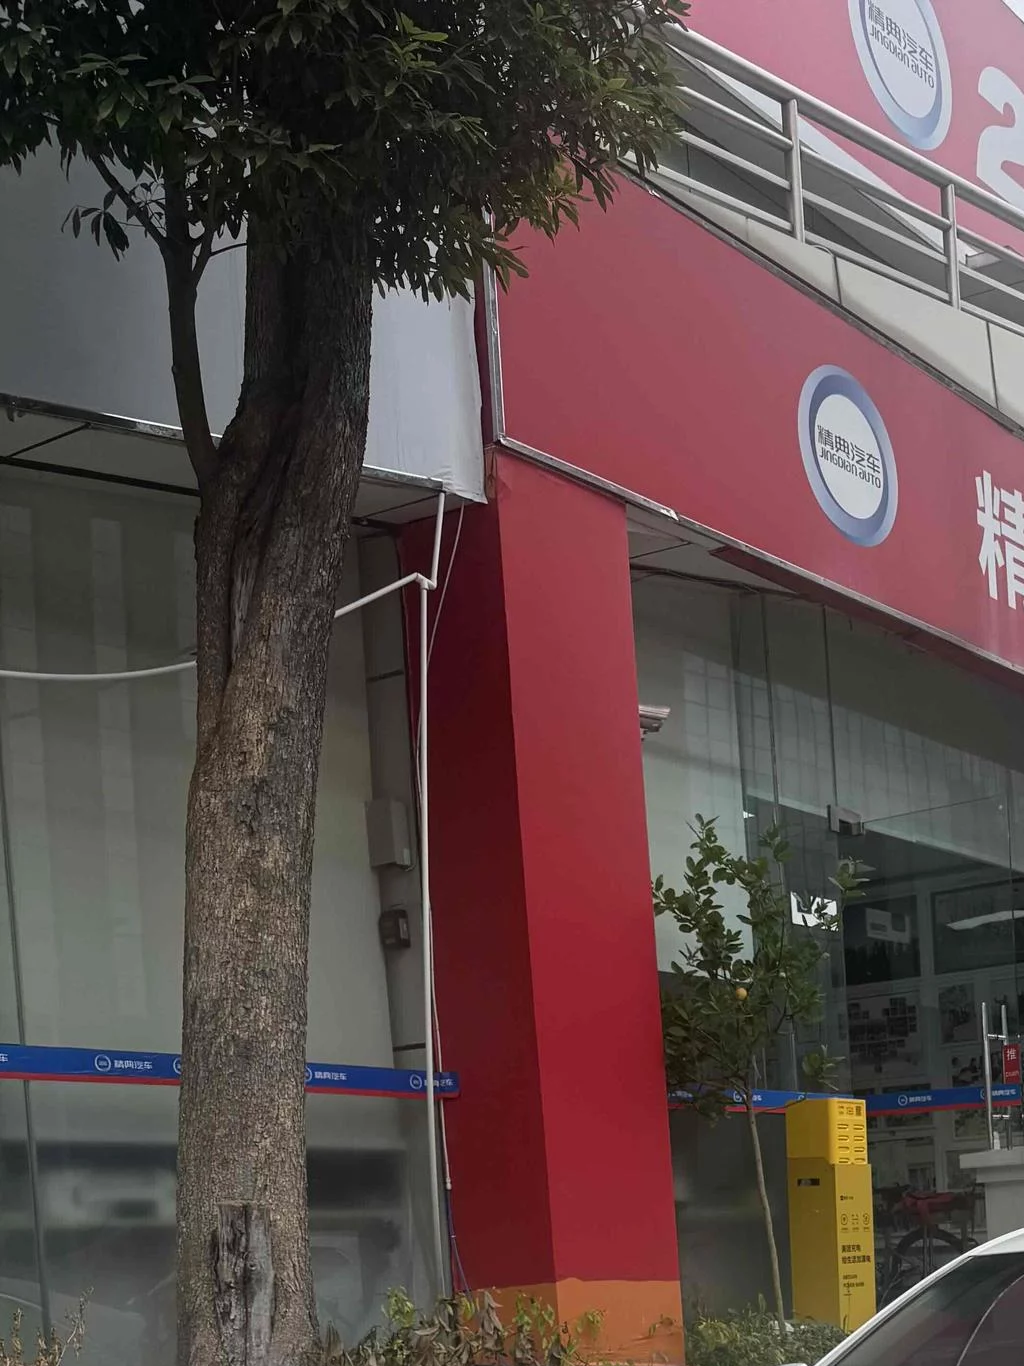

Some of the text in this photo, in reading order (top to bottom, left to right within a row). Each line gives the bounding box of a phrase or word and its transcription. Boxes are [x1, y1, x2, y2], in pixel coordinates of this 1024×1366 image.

[867, 0, 934, 72] 精典汽车
[816, 424, 880, 473] 精典汽车
